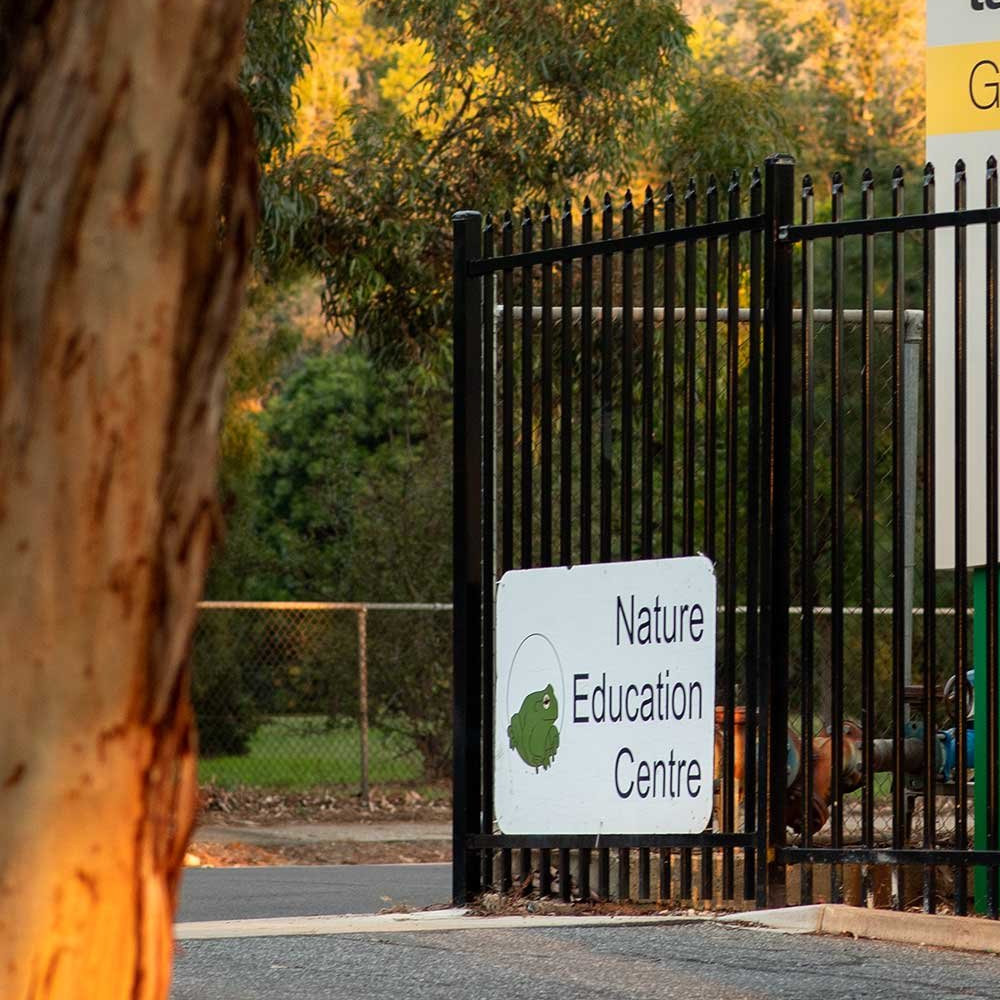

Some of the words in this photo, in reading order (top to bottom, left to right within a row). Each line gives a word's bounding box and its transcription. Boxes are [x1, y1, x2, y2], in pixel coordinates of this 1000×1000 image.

[616, 595, 704, 646] Nature
[573, 670, 703, 723] Education
[614, 747, 701, 799] Centre
